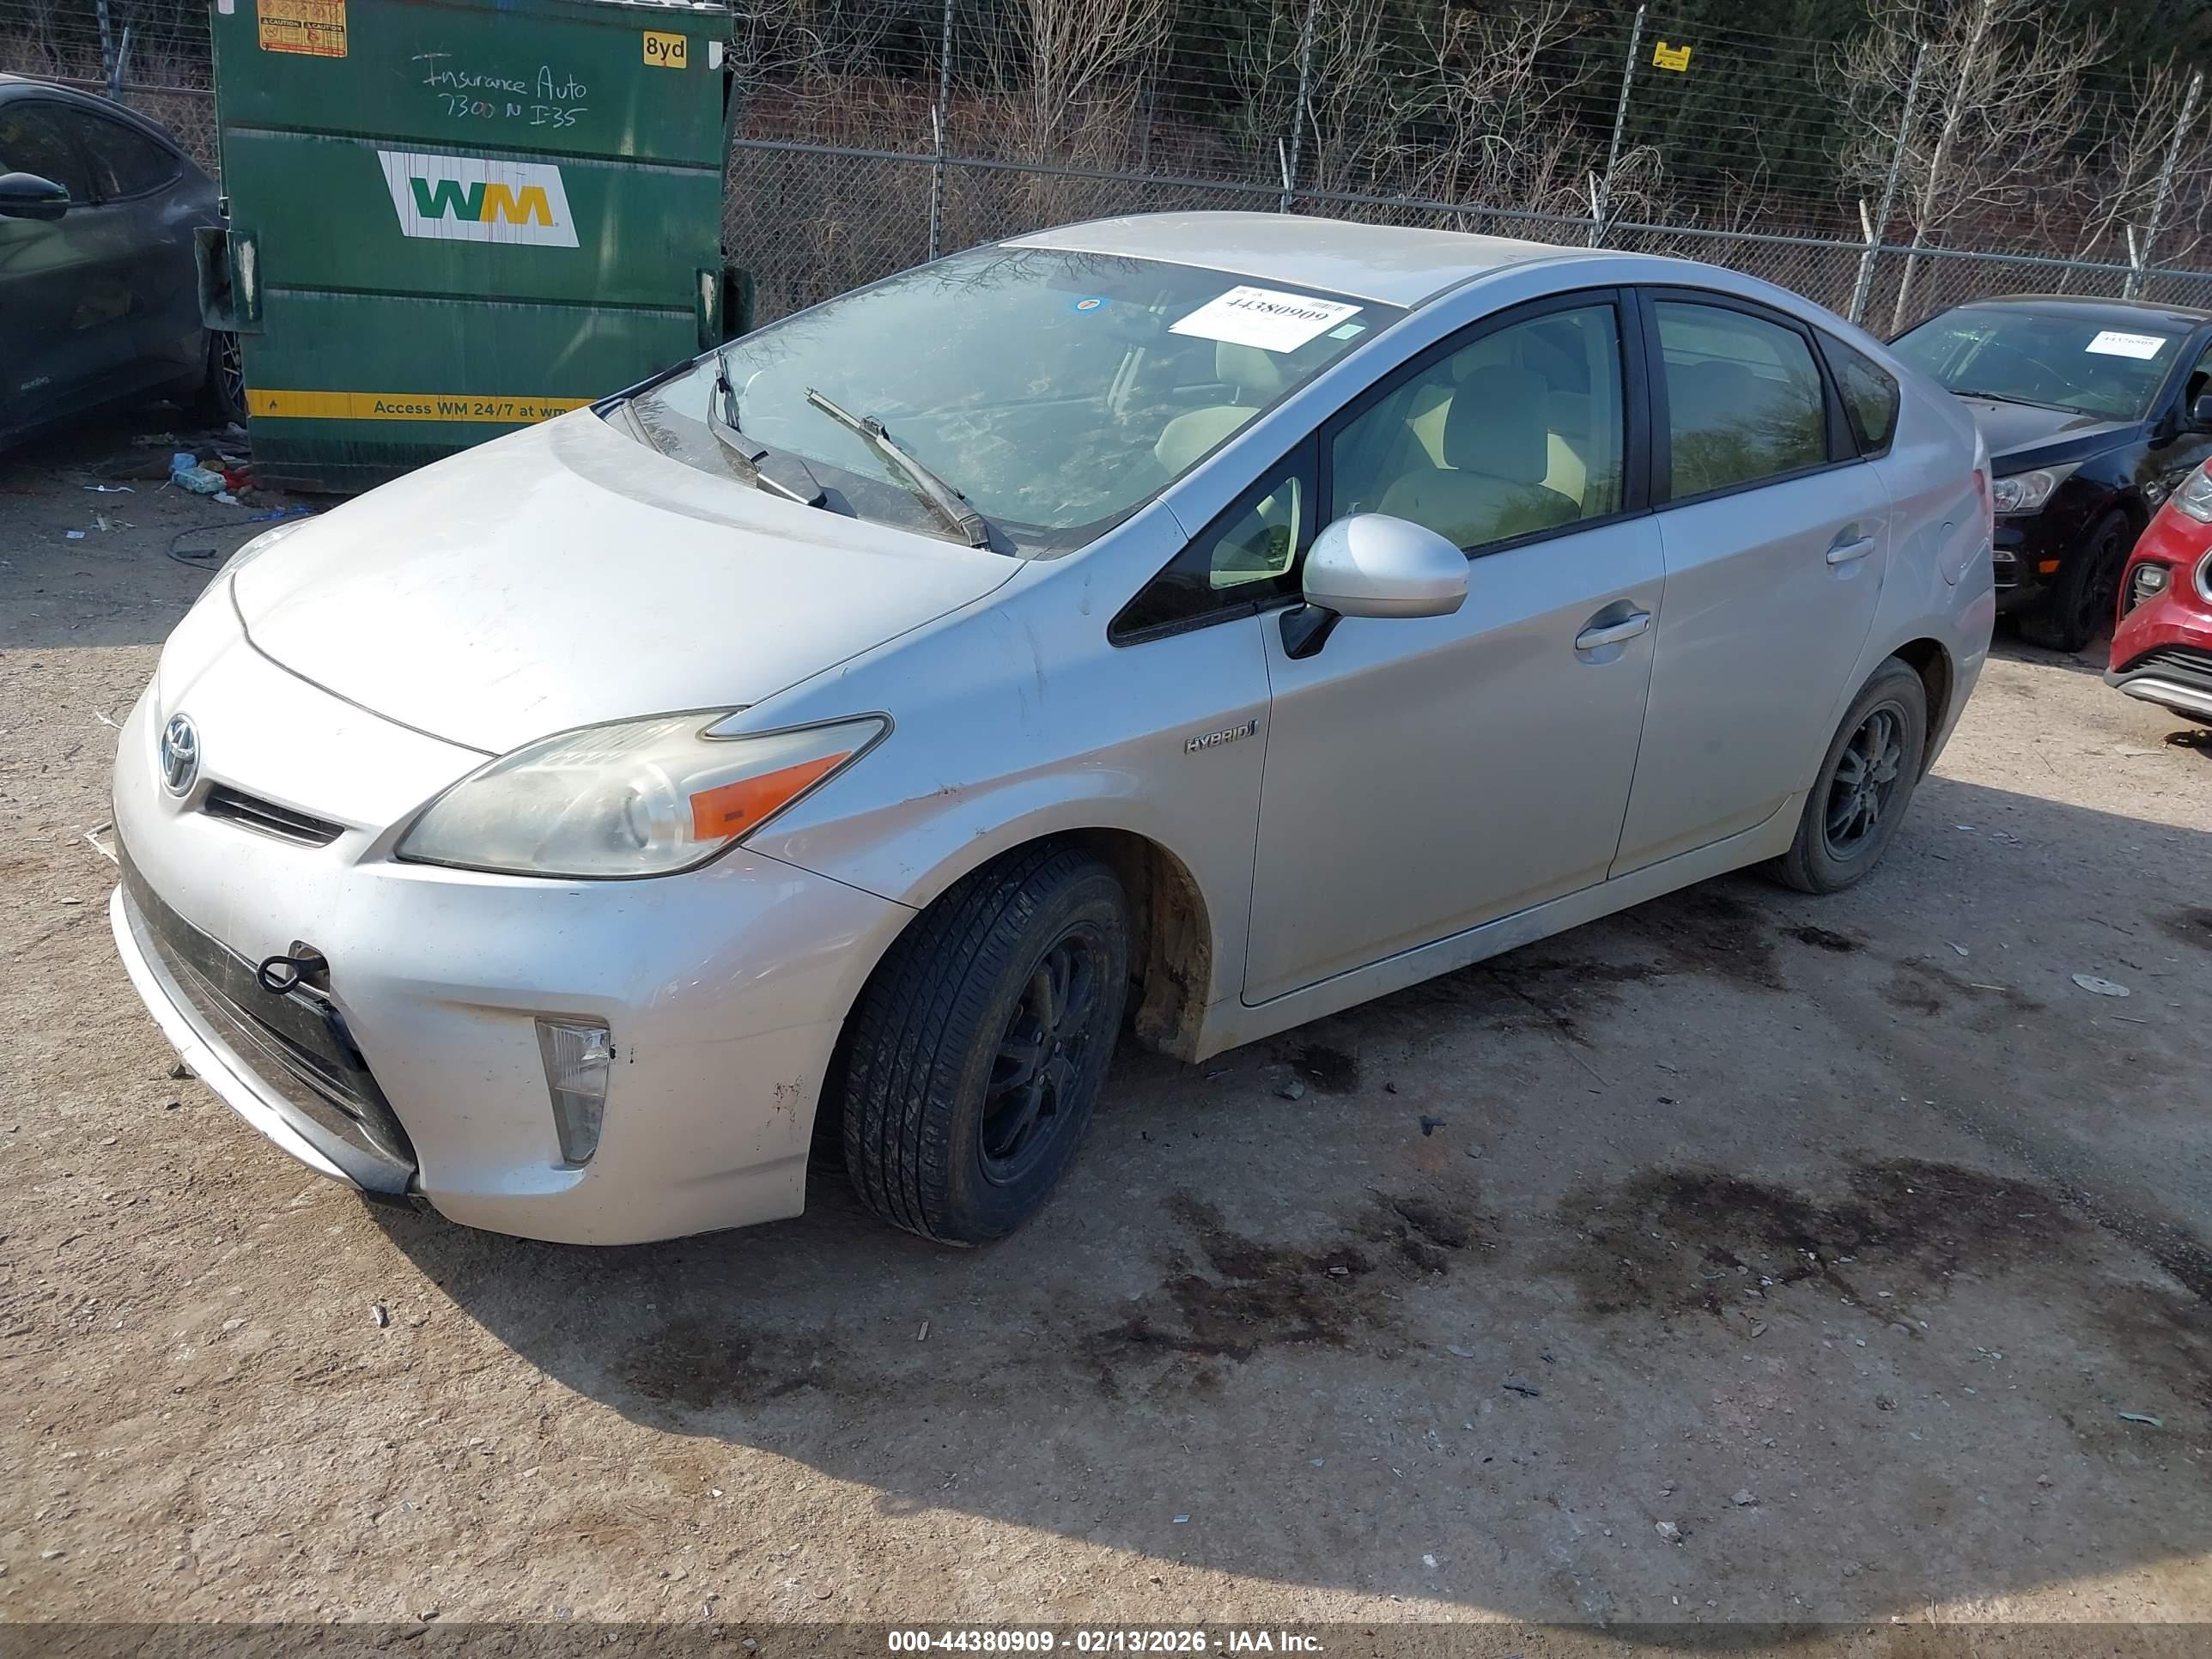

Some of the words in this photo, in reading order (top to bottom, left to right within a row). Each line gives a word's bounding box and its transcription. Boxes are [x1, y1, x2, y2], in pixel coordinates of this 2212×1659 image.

[646, 37, 684, 61] 8yd
[412, 52, 527, 94] Insurance
[537, 65, 587, 100] Auto
[506, 102, 522, 118] N
[410, 177, 554, 228] WM
[1225, 298, 1329, 323] 44380909
[374, 400, 432, 415] Access
[437, 402, 468, 416] WM
[474, 403, 514, 416] 24/7
[520, 405, 534, 417] at
[1184, 726, 1249, 754] HYBRID
